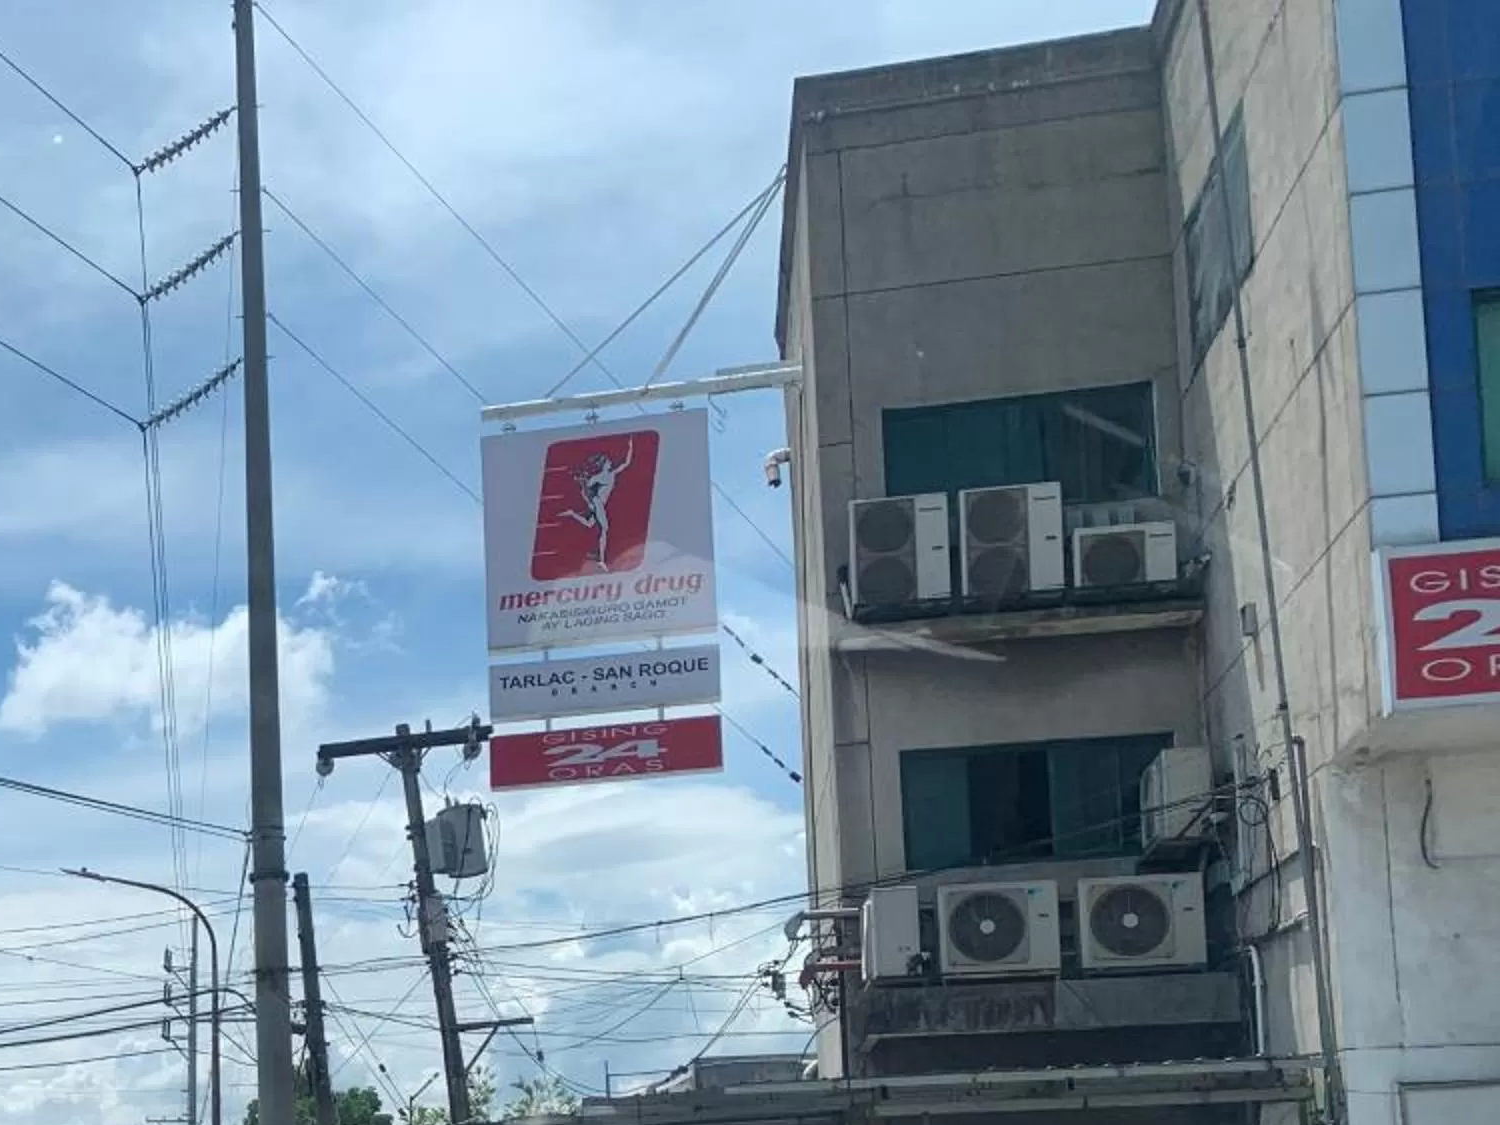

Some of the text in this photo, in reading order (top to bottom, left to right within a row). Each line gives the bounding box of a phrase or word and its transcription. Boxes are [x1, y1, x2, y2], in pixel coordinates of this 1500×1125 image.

[500, 573, 704, 611] mercury drug
[500, 671, 575, 690] TARLAC
[593, 665, 633, 681] SAN
[639, 657, 709, 677] ROQUE
[542, 723, 669, 744] GISING
[542, 739, 669, 767] 24
[549, 759, 665, 779] ORAS
